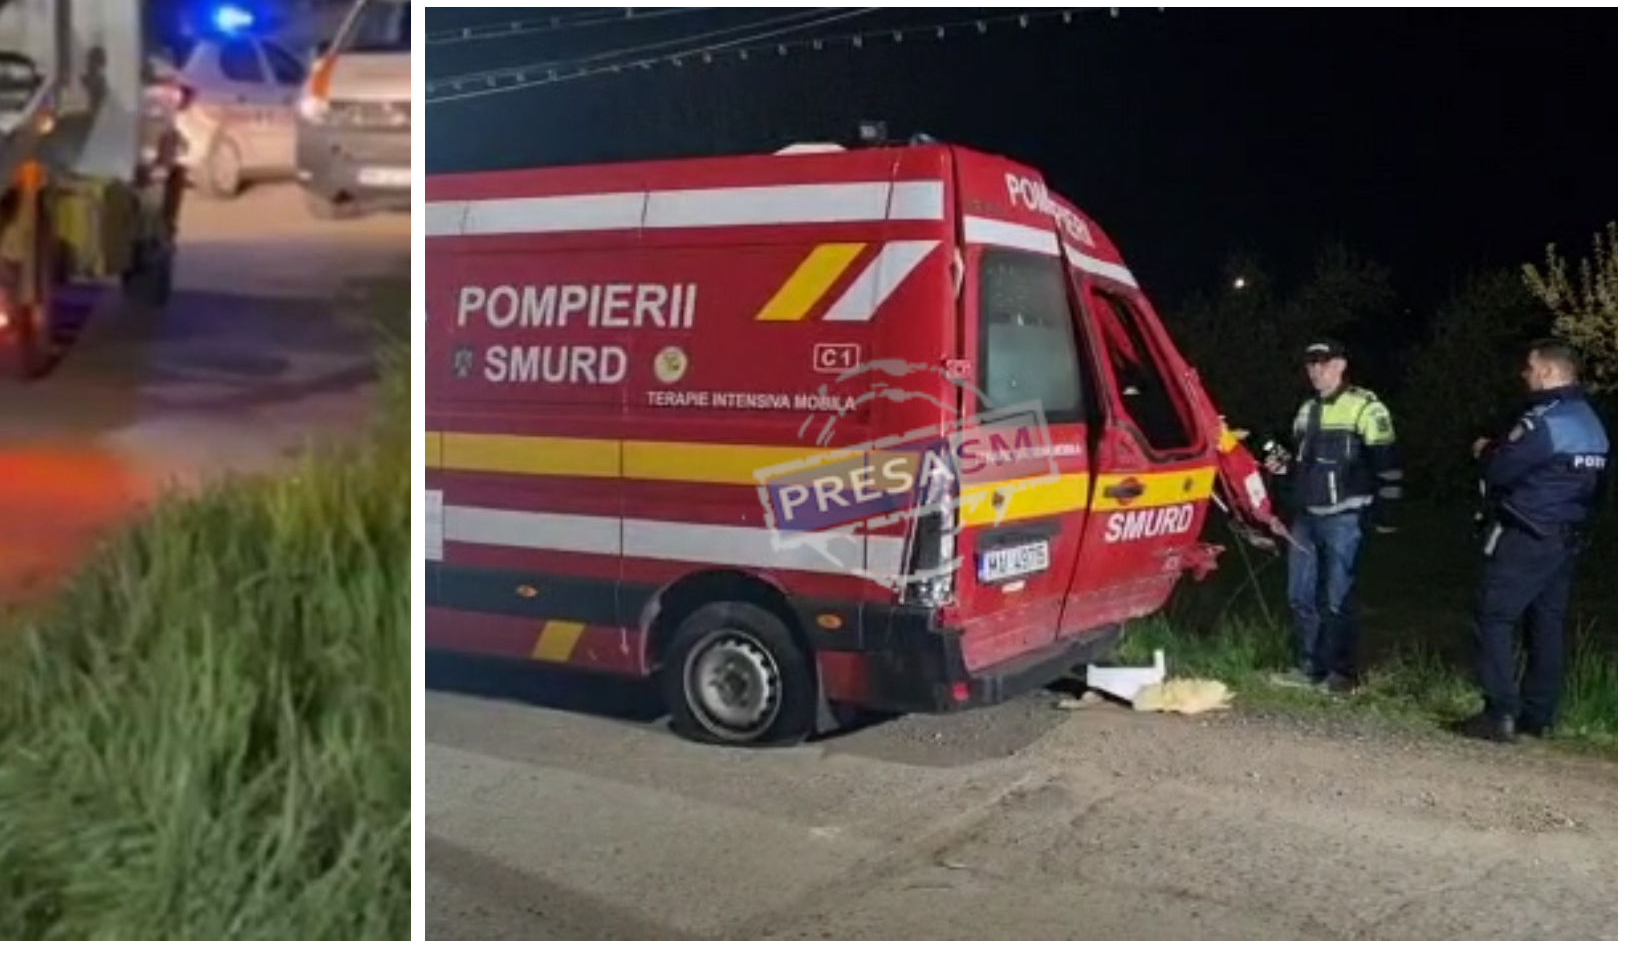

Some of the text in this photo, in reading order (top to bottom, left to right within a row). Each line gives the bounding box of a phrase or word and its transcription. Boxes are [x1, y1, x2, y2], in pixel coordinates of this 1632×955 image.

[458, 284, 698, 329] POMPIERII
[484, 345, 628, 384] SMURD
[648, 390, 857, 411] TERAPIE INTENSIVA MOBILA
[1104, 504, 1195, 543] SMURD
